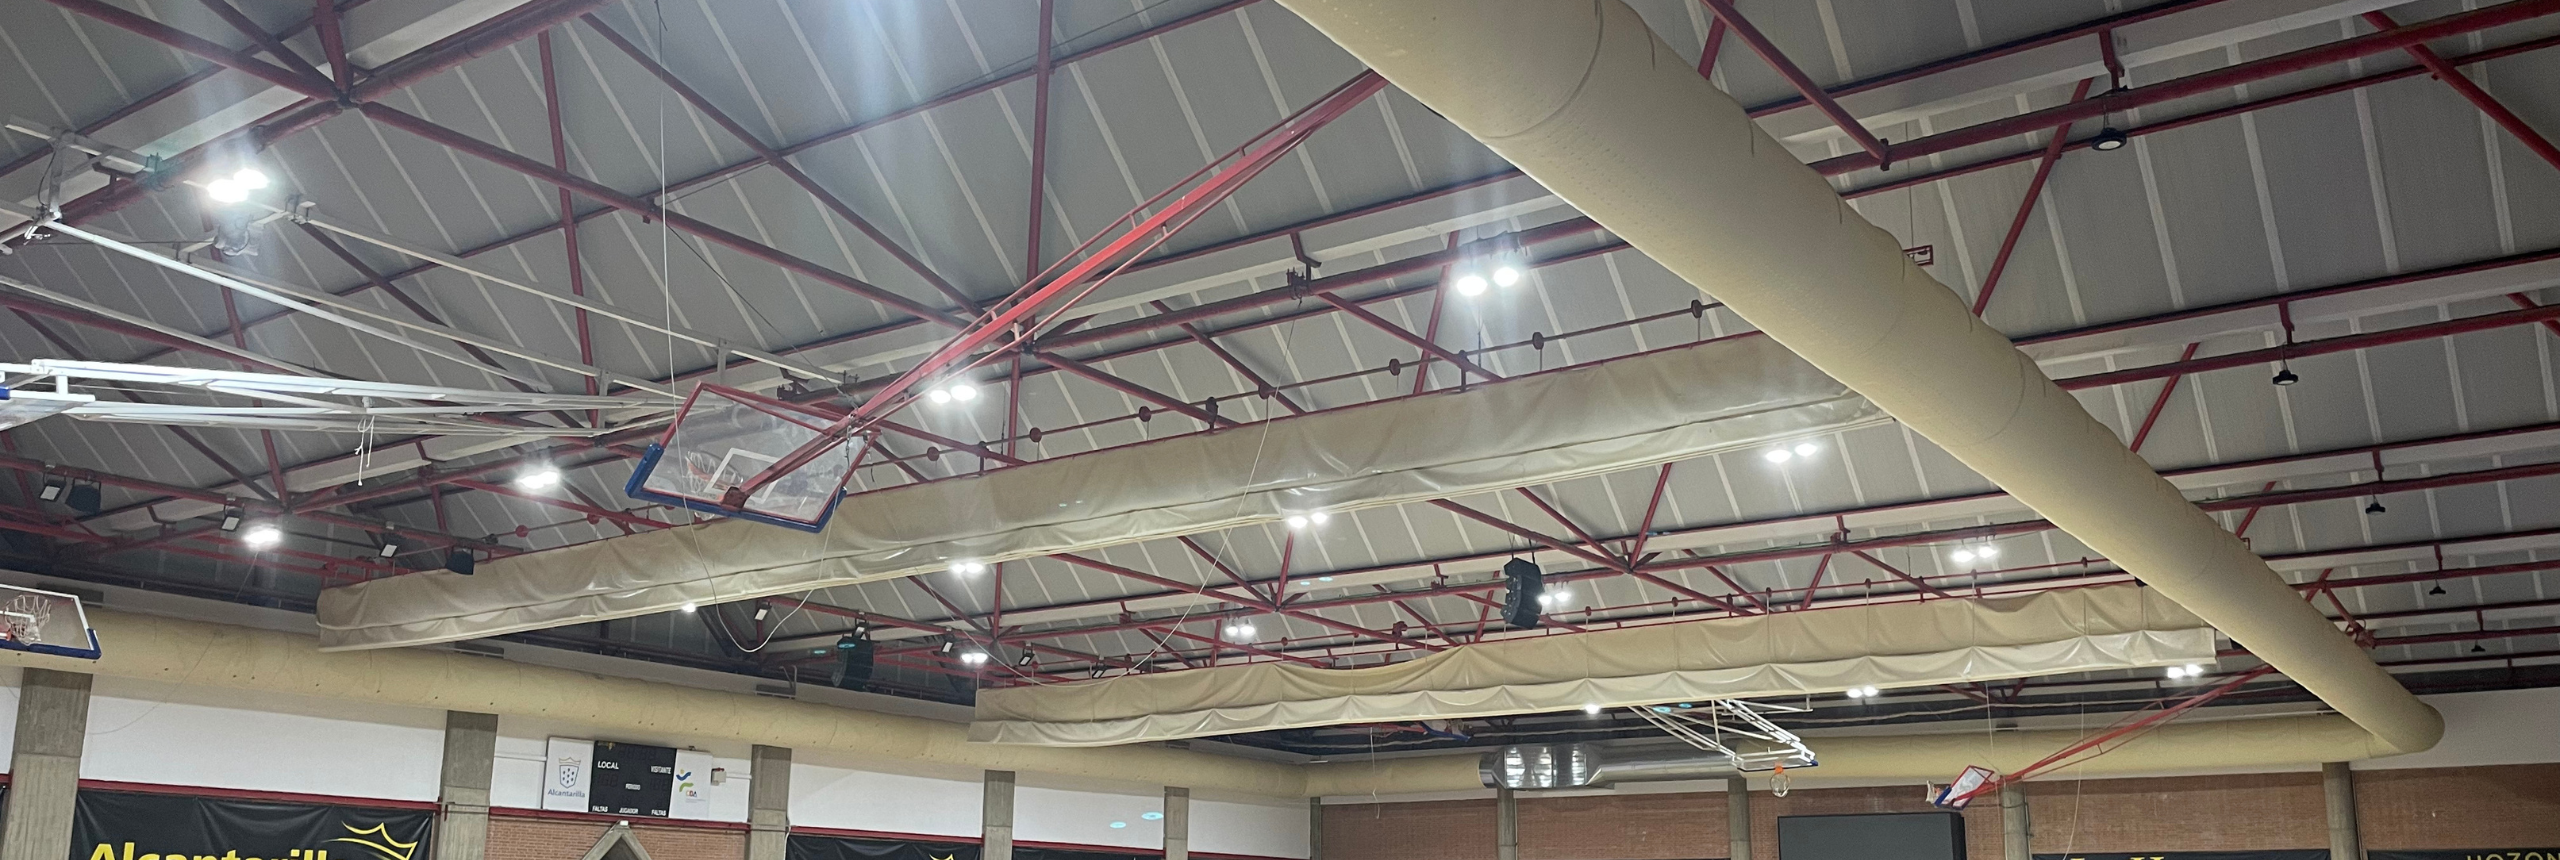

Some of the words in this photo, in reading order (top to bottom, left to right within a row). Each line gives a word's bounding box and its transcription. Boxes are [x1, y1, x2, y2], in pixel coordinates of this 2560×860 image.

[597, 761, 619, 770] LOCAL
[548, 788, 586, 798] Alcantarilla
[592, 805, 608, 813] FALTAS
[651, 809, 667, 817] FALTAS
